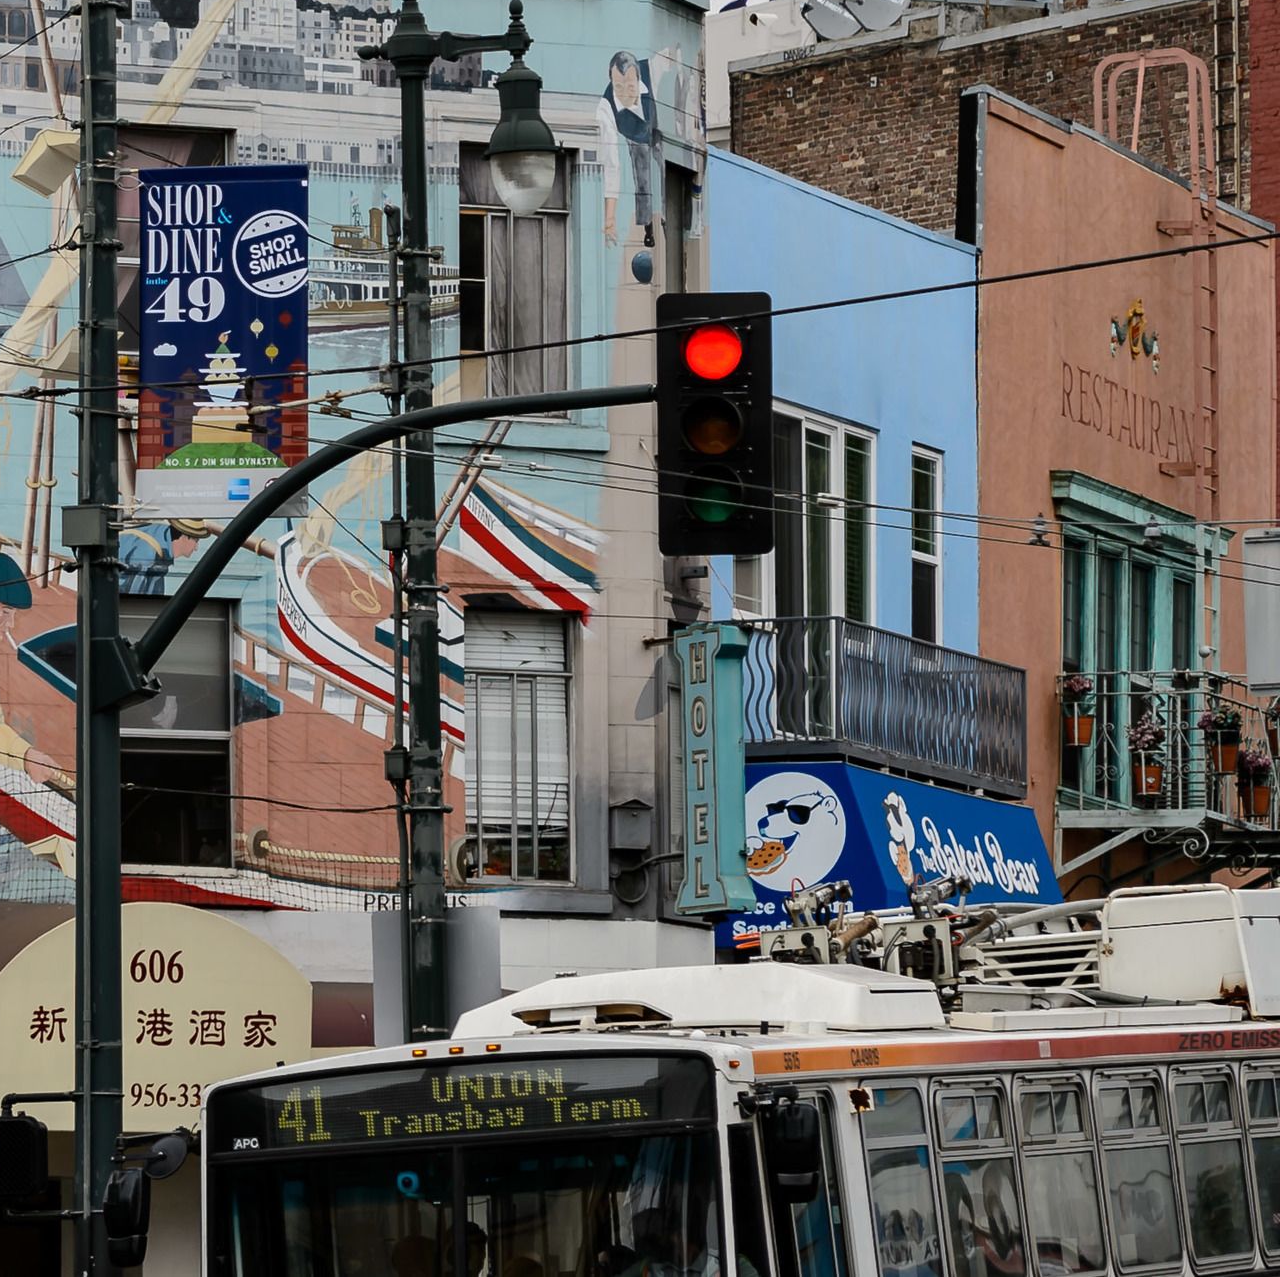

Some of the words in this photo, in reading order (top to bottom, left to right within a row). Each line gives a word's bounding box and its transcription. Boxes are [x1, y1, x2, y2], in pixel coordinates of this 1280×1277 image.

[147, 183, 223, 227] SHOP
[146, 228, 223, 274] DINE
[249, 234, 296, 259] SHOP
[249, 248, 305, 275] SMALL
[145, 276, 226, 323] 49
[185, 458, 191, 466] 5
[238, 457, 278, 466] DYNASTY
[689, 641, 710, 899] HOTEL
[921, 816, 992, 885] Baked
[984, 831, 1040, 895] Bear
[130, 949, 185, 984] 606
[30, 1005, 278, 1048] 新港酒家
[1178, 1032, 1226, 1050] ZERO
[131, 1083, 205, 1108] 956-33
[431, 1066, 565, 1103] UNION
[278, 1085, 331, 1143] 41
[359, 1103, 525, 1138] Transbay
[544, 1096, 650, 1124] Term.
